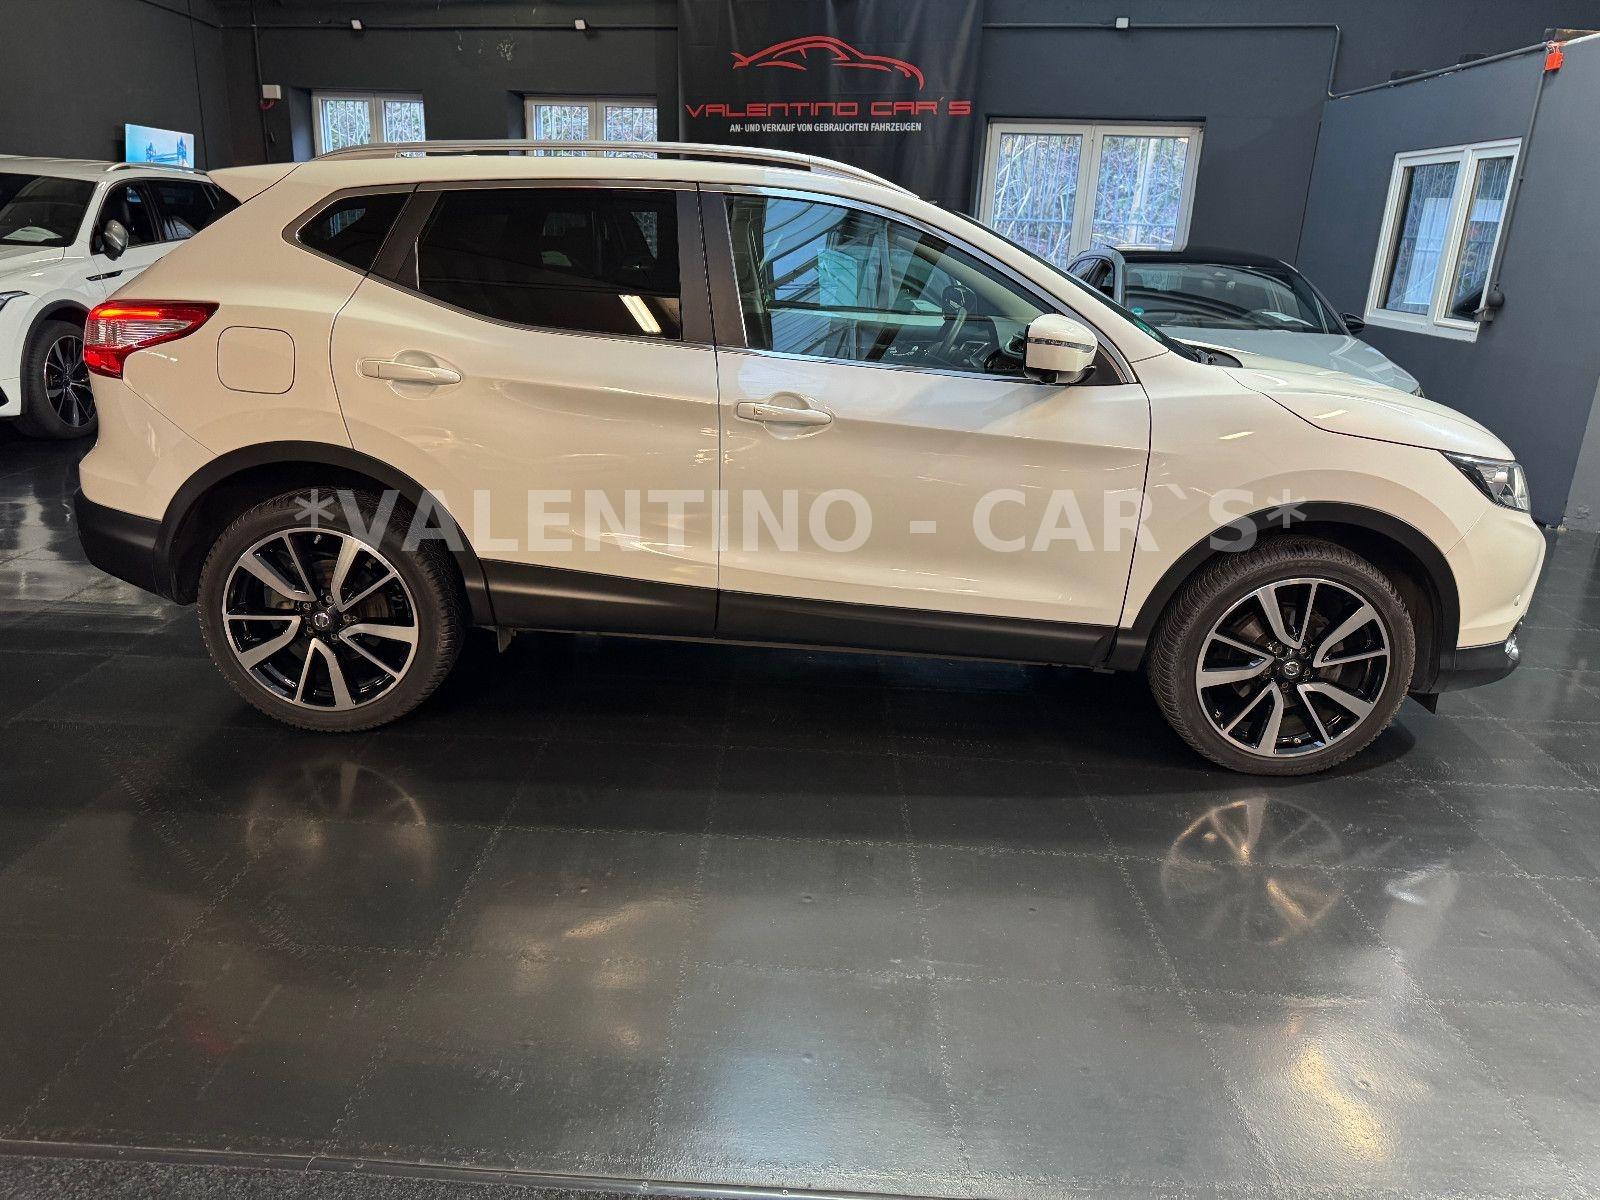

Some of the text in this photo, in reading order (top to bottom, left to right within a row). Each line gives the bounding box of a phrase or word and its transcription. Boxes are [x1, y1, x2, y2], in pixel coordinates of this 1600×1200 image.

[685, 102, 858, 118] VALENTINO
[729, 122, 922, 133] AN- UND VERKAUF VON GEBRAUCHTEN FAHRZEUGEN
